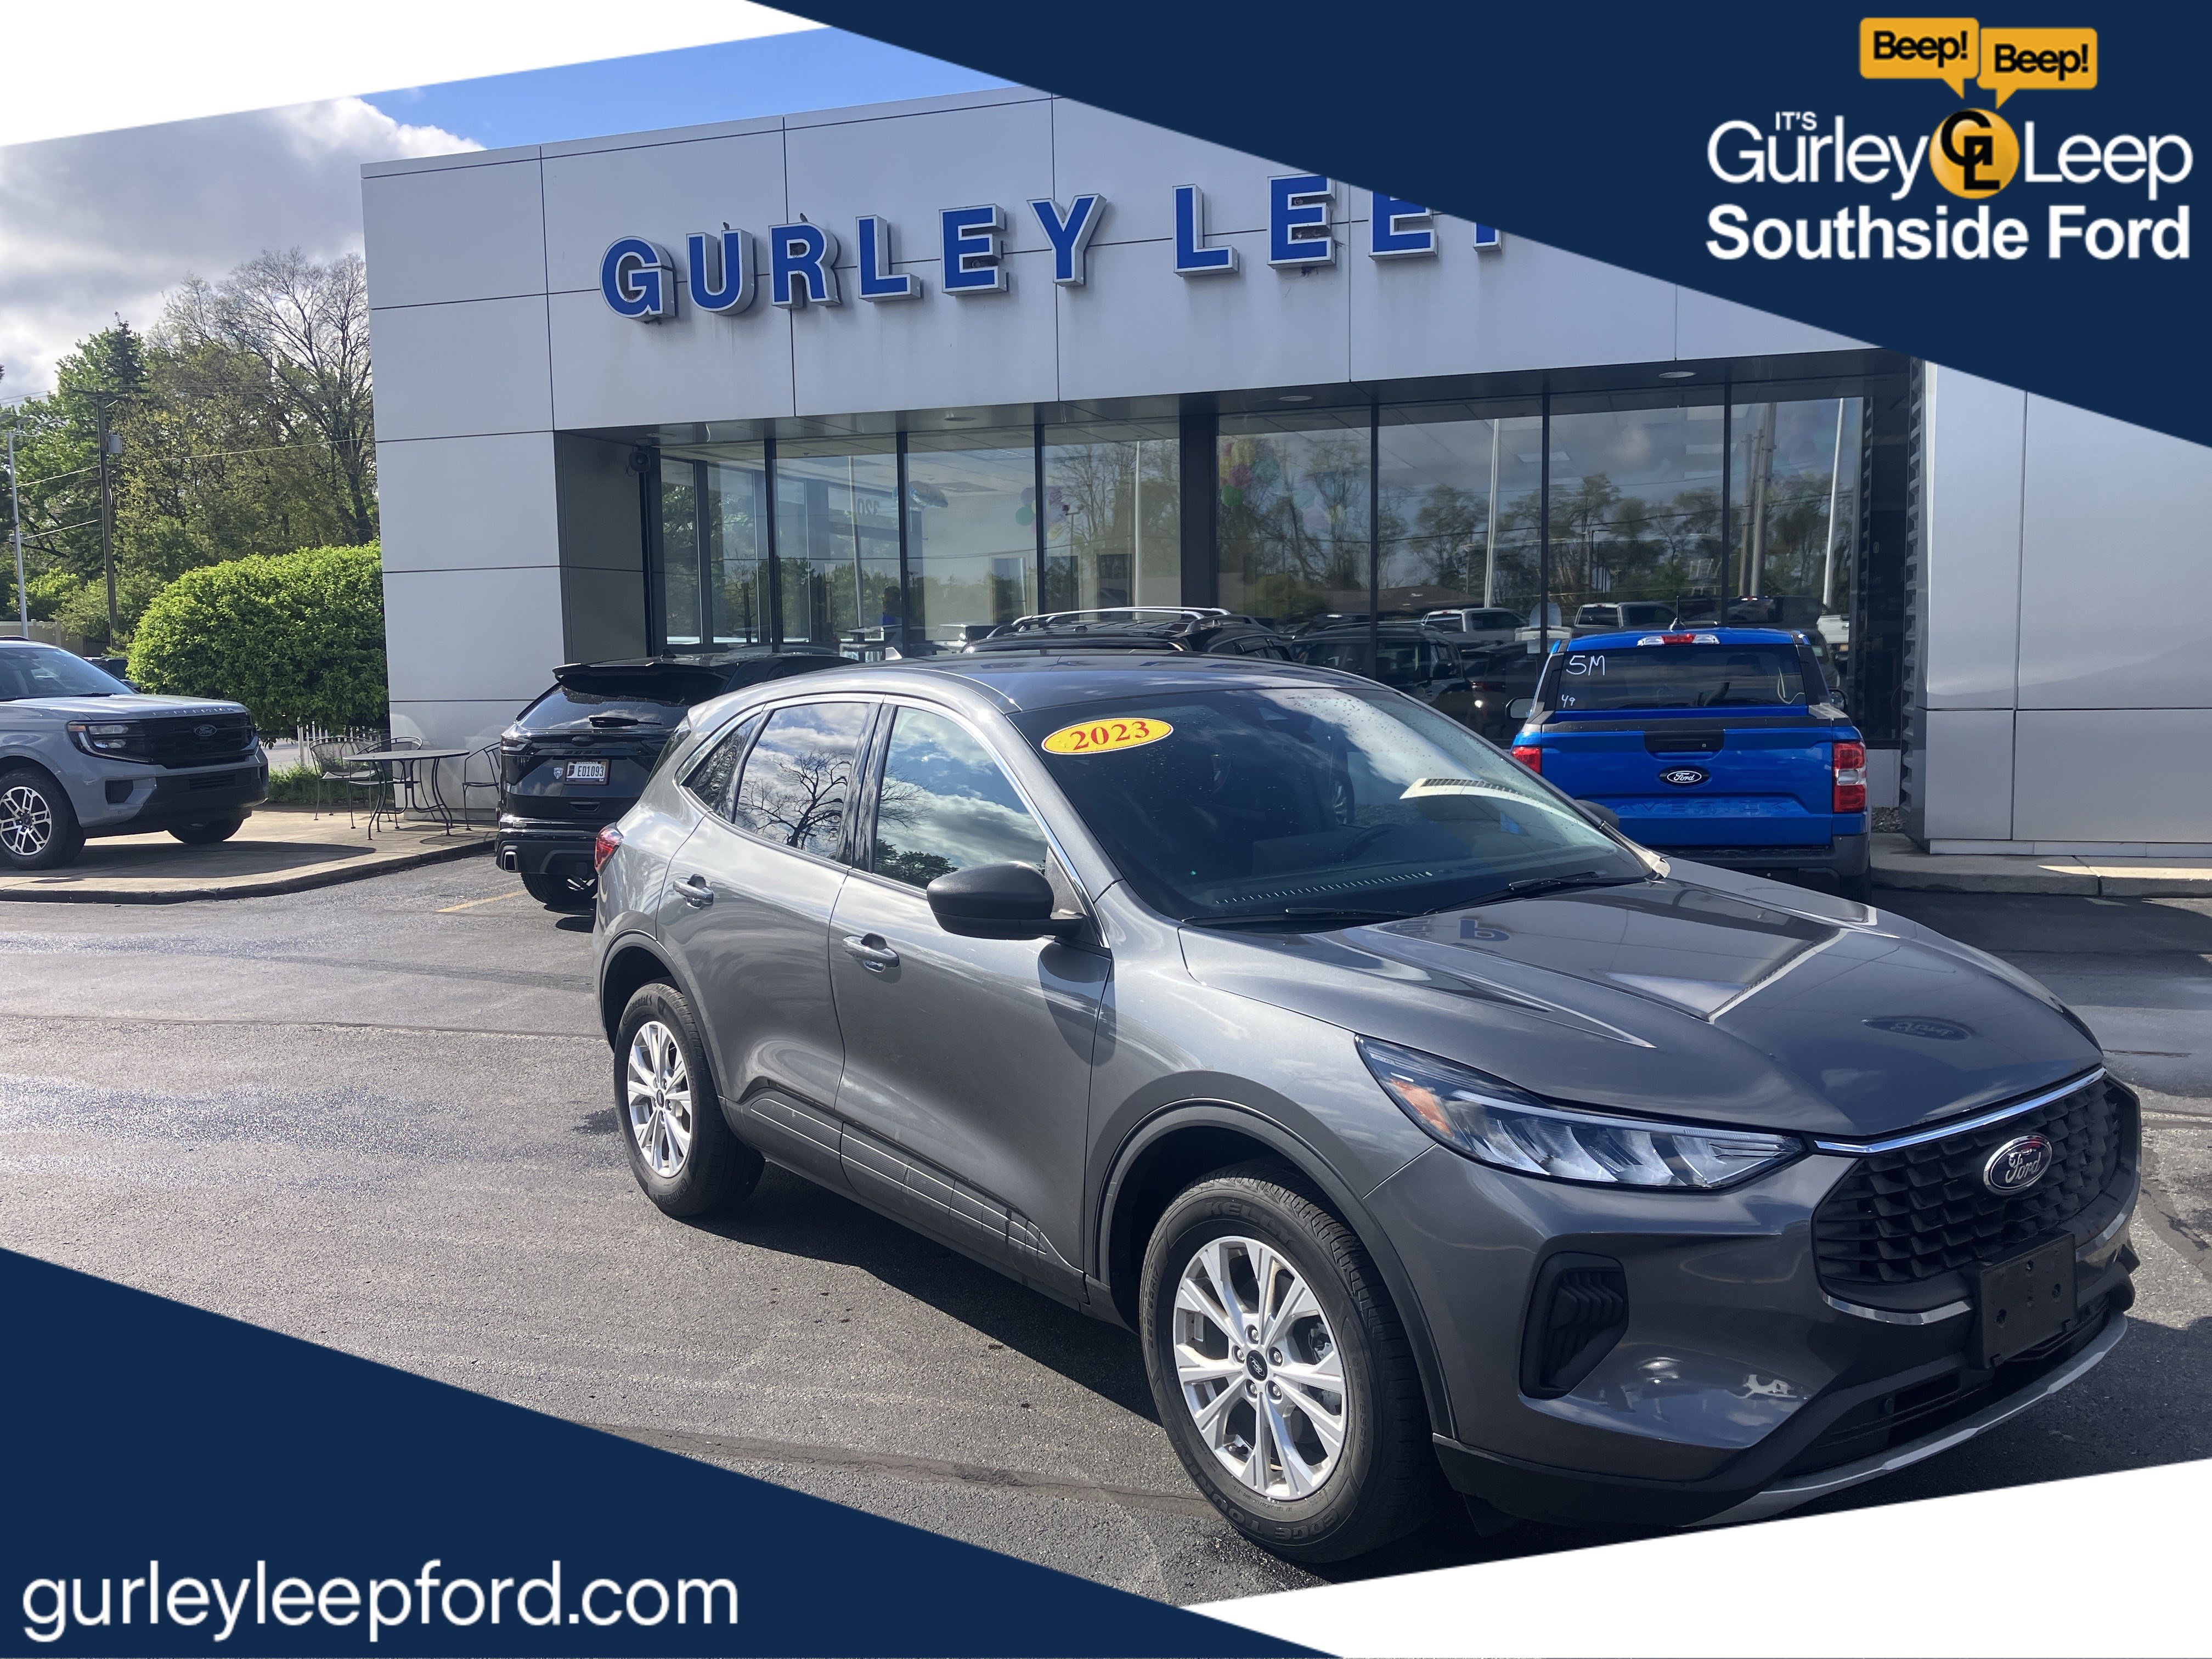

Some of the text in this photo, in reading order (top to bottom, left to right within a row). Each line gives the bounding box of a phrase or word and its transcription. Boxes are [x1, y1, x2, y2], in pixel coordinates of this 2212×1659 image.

[599, 172, 1502, 324] GURLEY LEE
[1069, 721, 1150, 751] 2023
[1673, 772, 1696, 781] Ford
[2005, 1148, 2042, 1184] Ford
